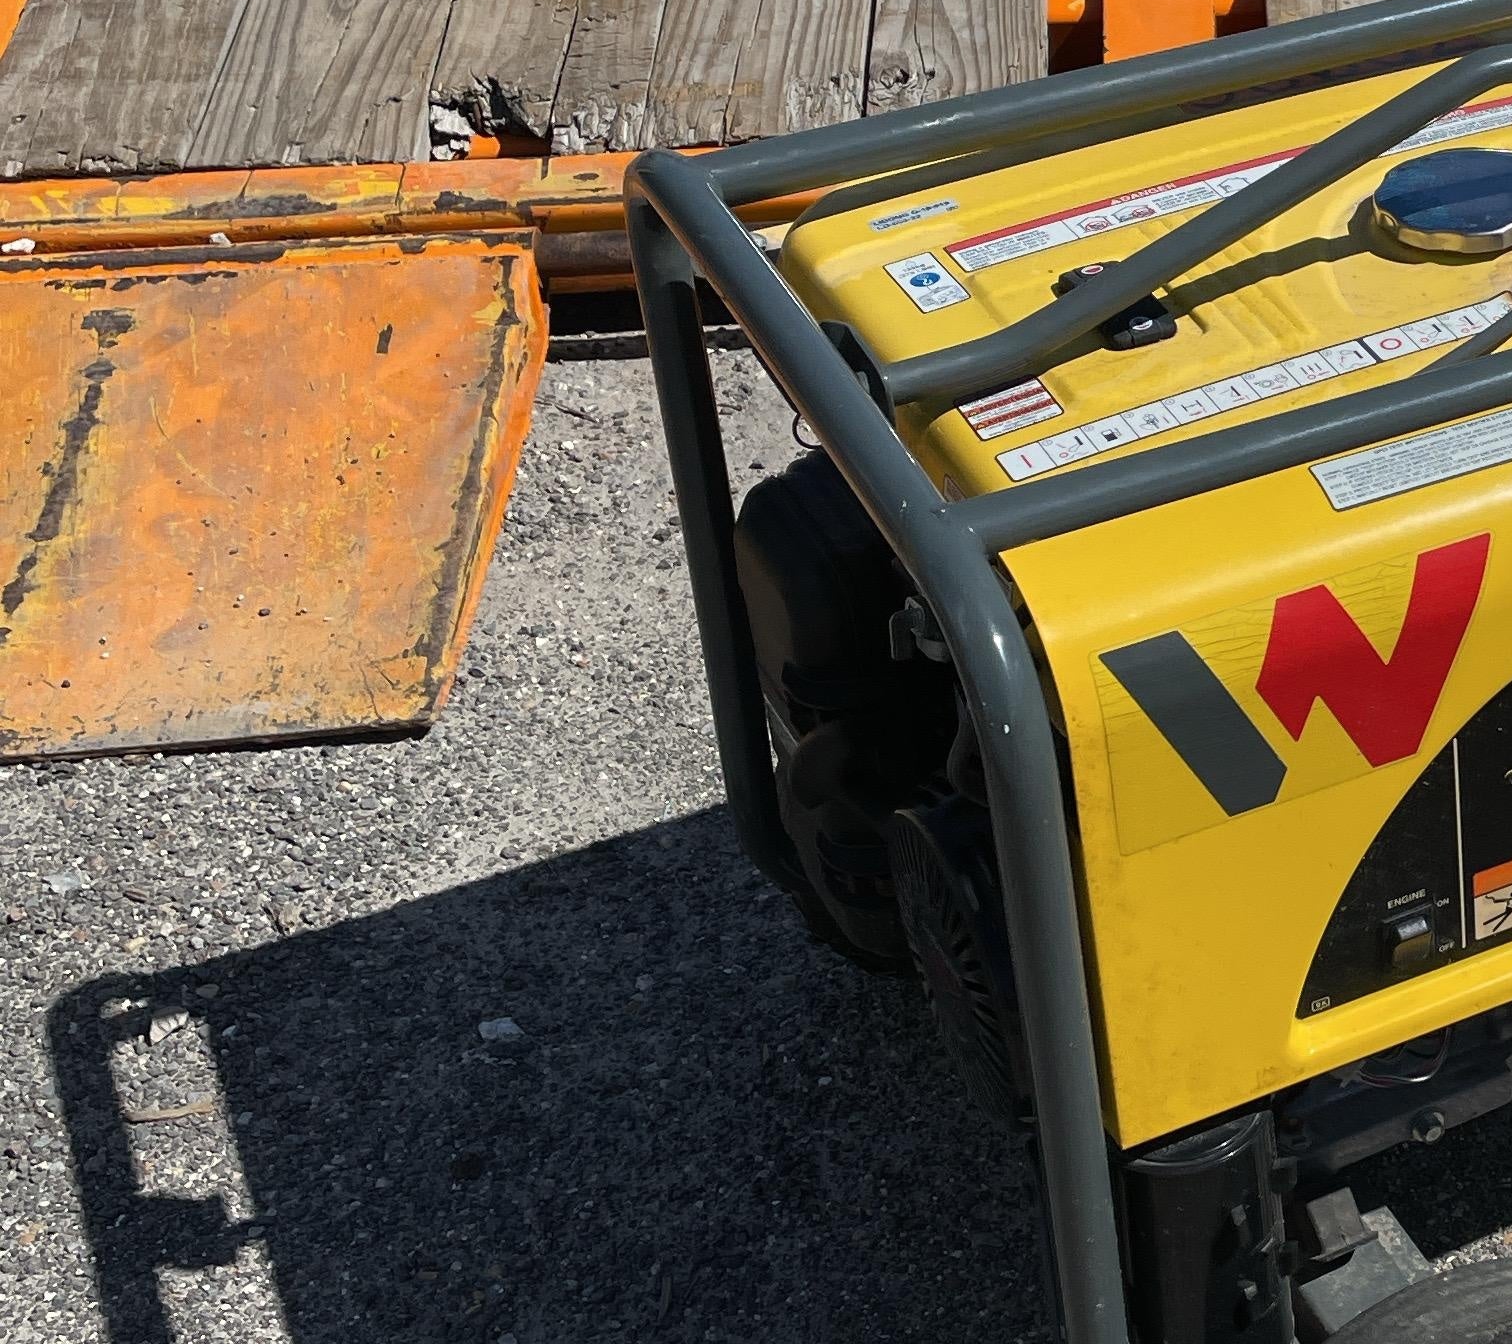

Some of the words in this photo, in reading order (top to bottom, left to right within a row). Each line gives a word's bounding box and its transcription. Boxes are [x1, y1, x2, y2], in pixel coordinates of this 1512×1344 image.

[1387, 888, 1426, 909] ENGINE
[1436, 897, 1450, 908] ON
[1438, 940, 1455, 952] OFF
